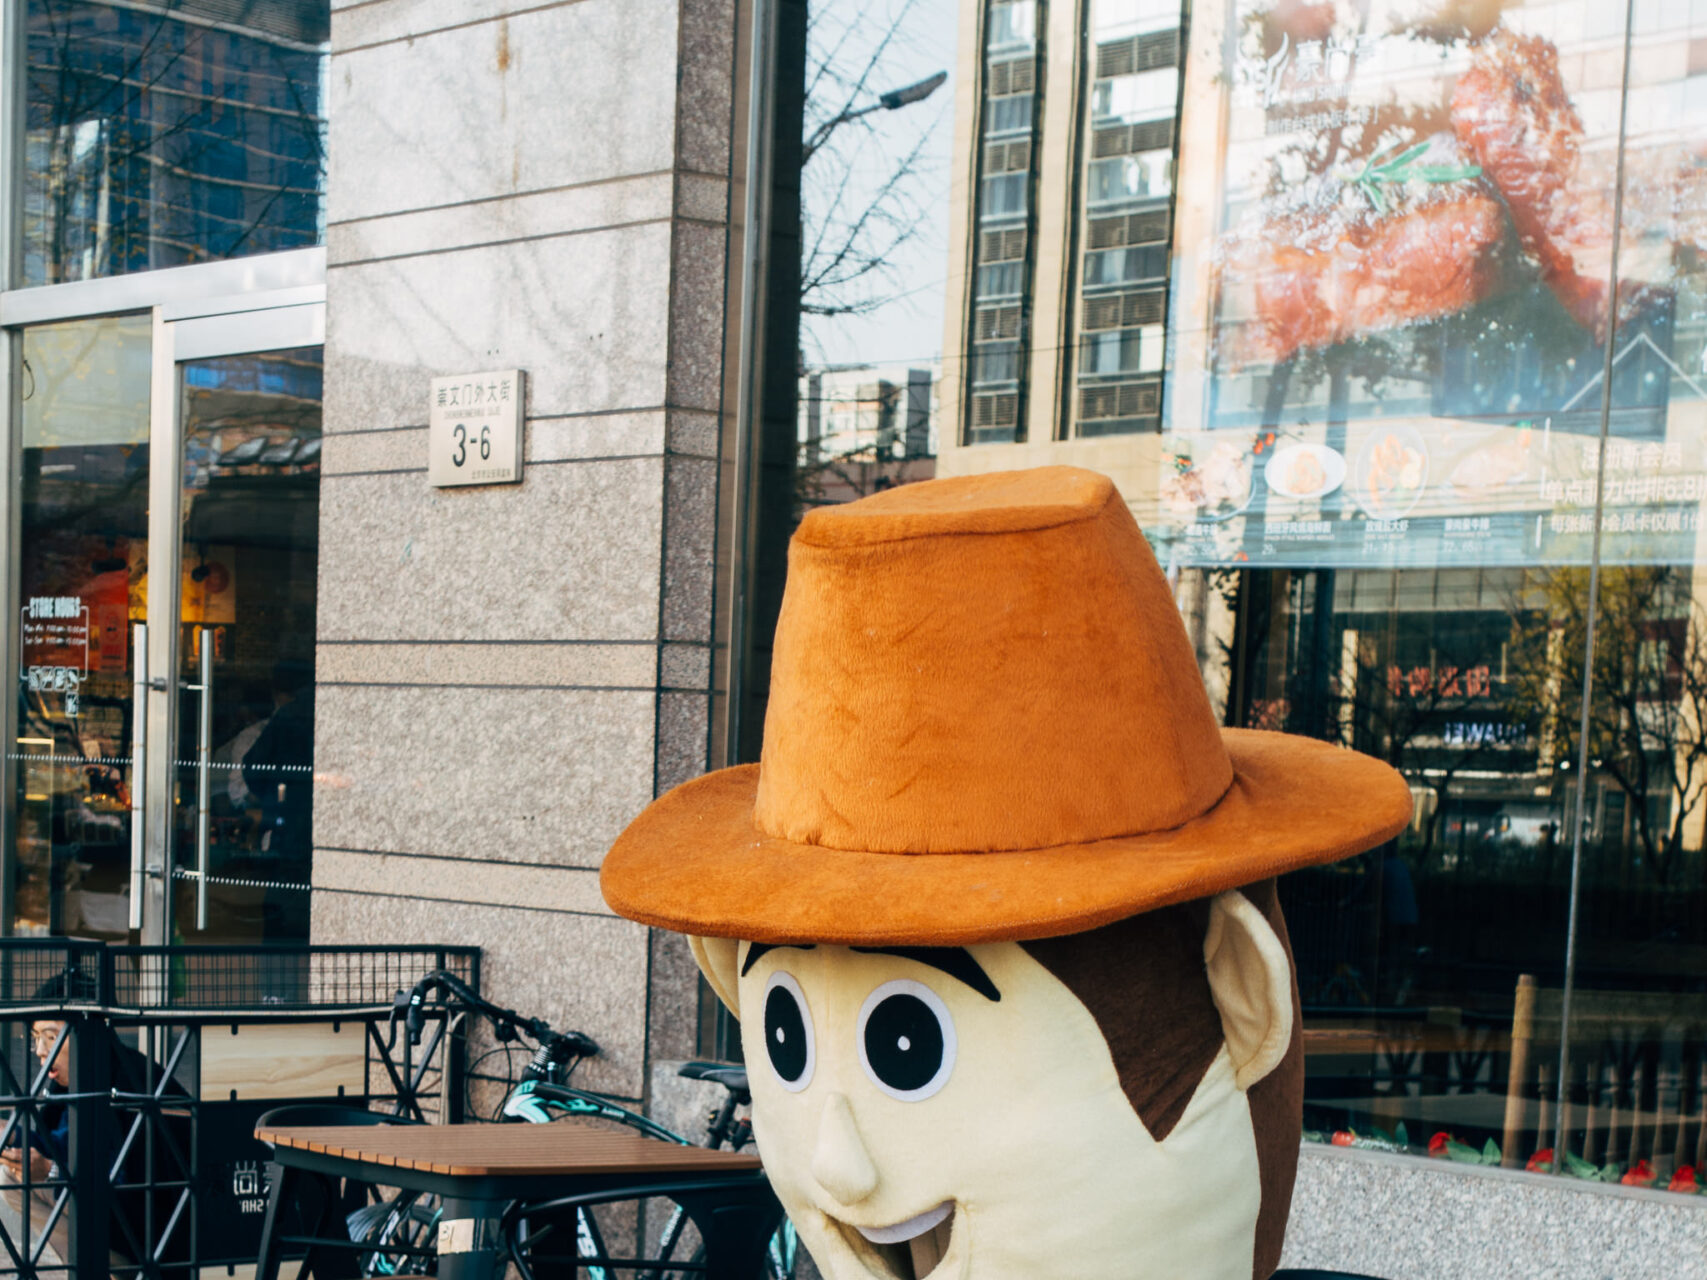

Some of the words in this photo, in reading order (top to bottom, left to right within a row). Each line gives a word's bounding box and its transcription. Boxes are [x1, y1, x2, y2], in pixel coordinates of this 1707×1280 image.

[437, 380, 511, 407] 崇文门外大街
[453, 424, 491, 468] 3-6
